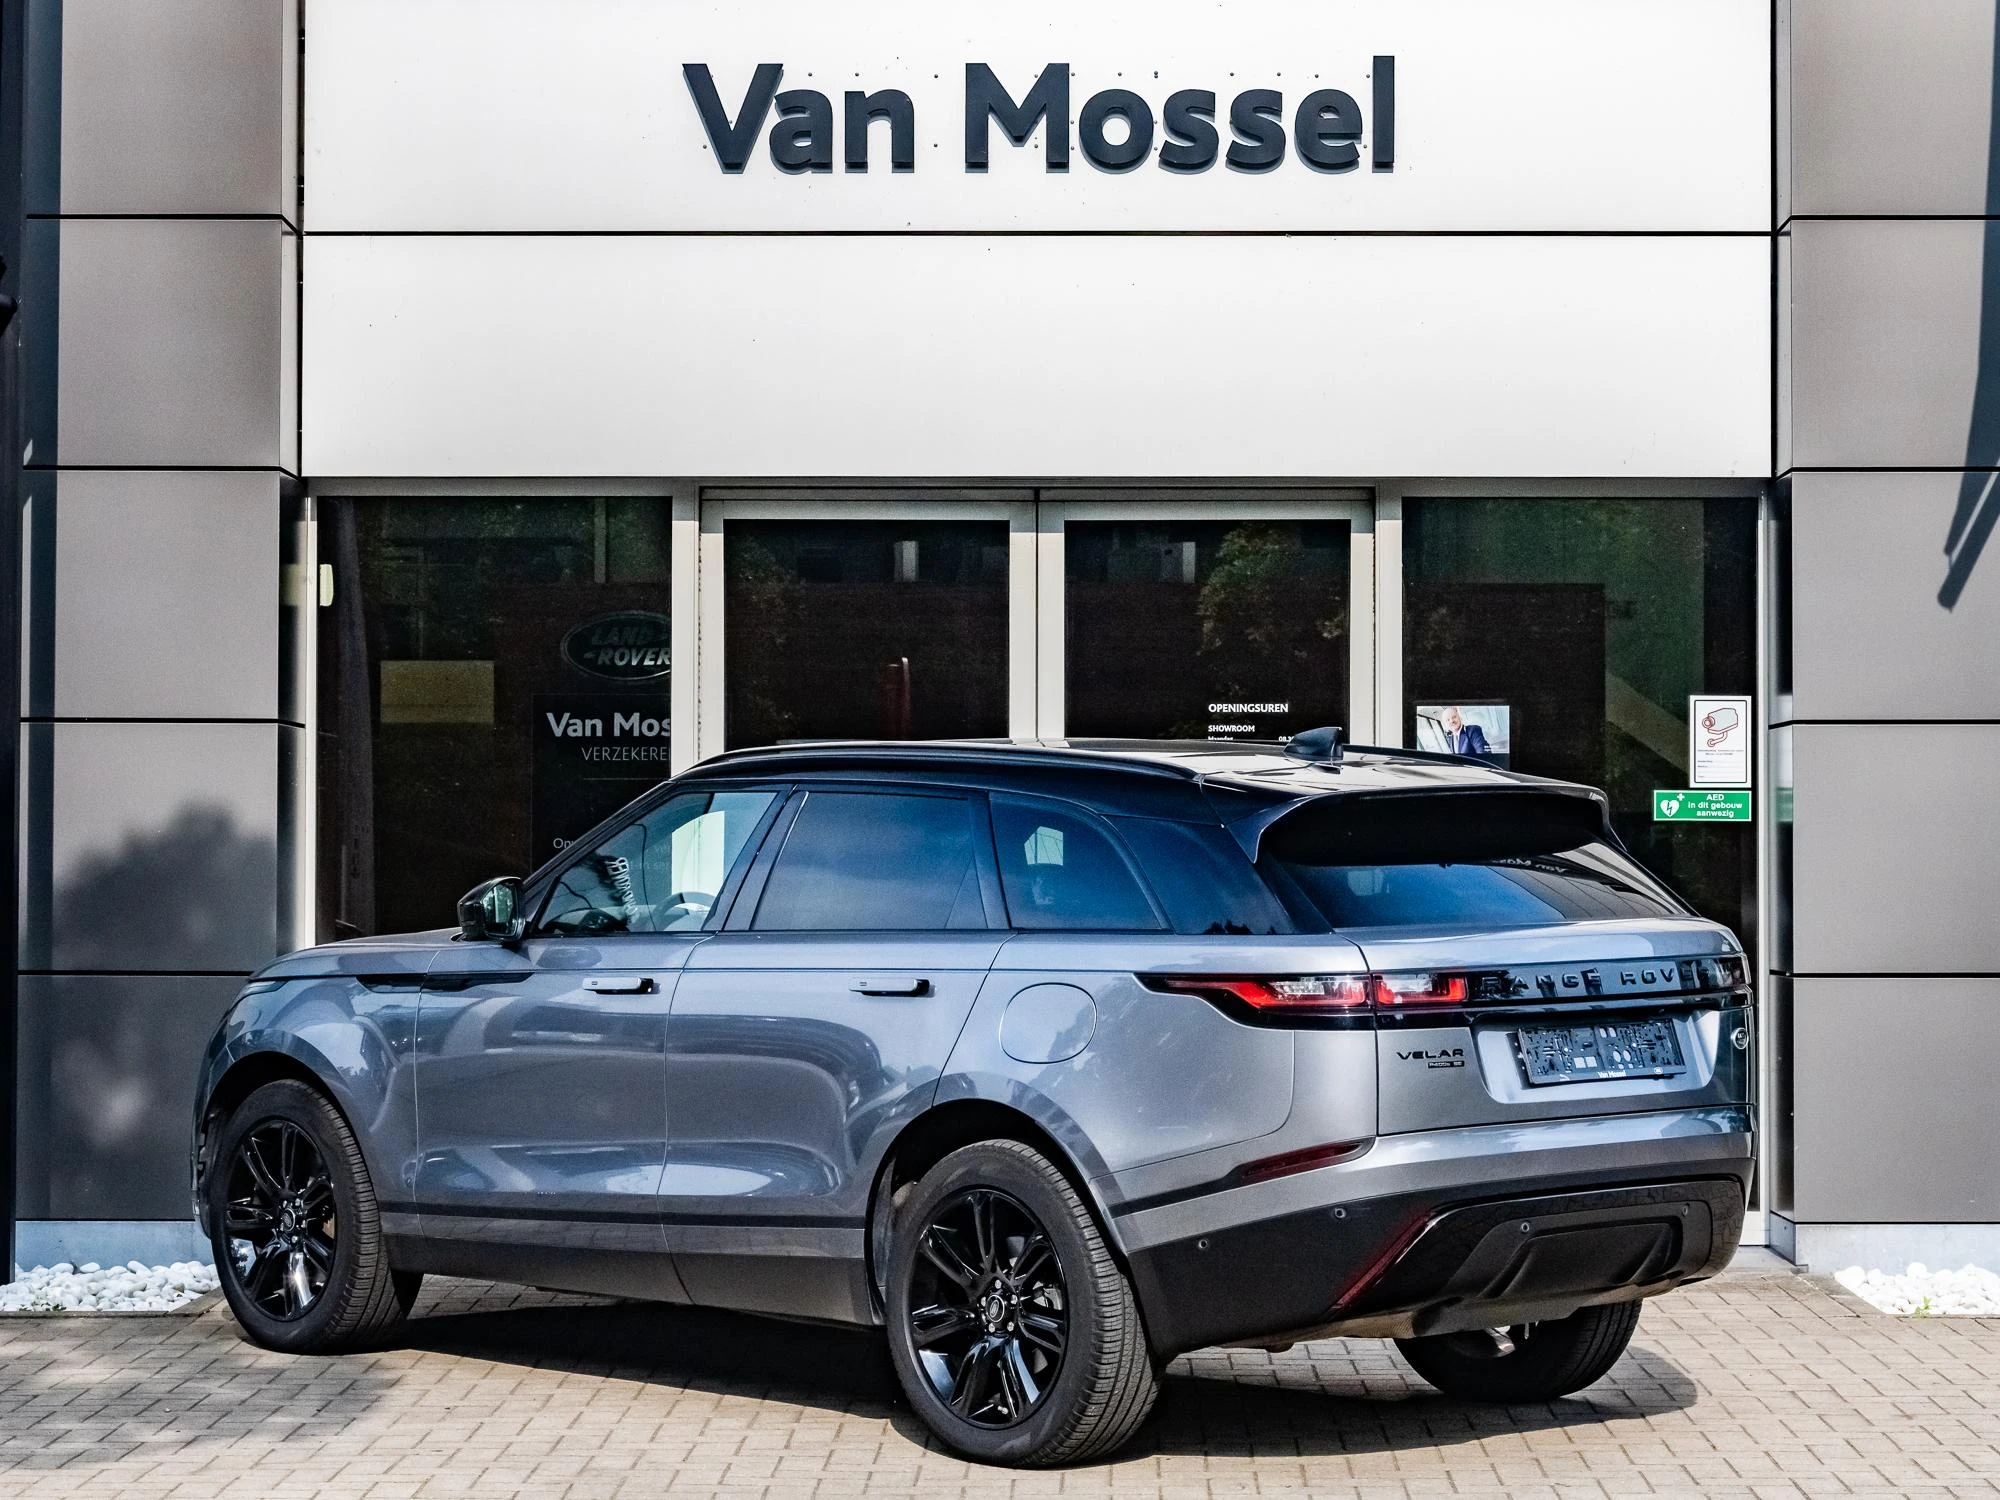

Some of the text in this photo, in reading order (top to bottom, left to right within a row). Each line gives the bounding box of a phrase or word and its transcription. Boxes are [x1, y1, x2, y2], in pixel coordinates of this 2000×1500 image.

[681, 55, 1396, 175] Van Mossel
[591, 627, 654, 645] LAND
[597, 647, 671, 666] ROVER
[1207, 703, 1289, 713] OPENINGSUREN
[546, 712, 603, 738] Van
[1207, 724, 1256, 733] SHOWROOM
[581, 747, 671, 761] VERZEKERE
[1706, 793, 1725, 801] AED
[1697, 801, 1709, 809] dit
[1710, 801, 1743, 811] gebouw
[1696, 809, 1735, 818] aanwezig
[1480, 971, 1602, 992] RANGE
[1396, 1048, 1464, 1060] VELAR
